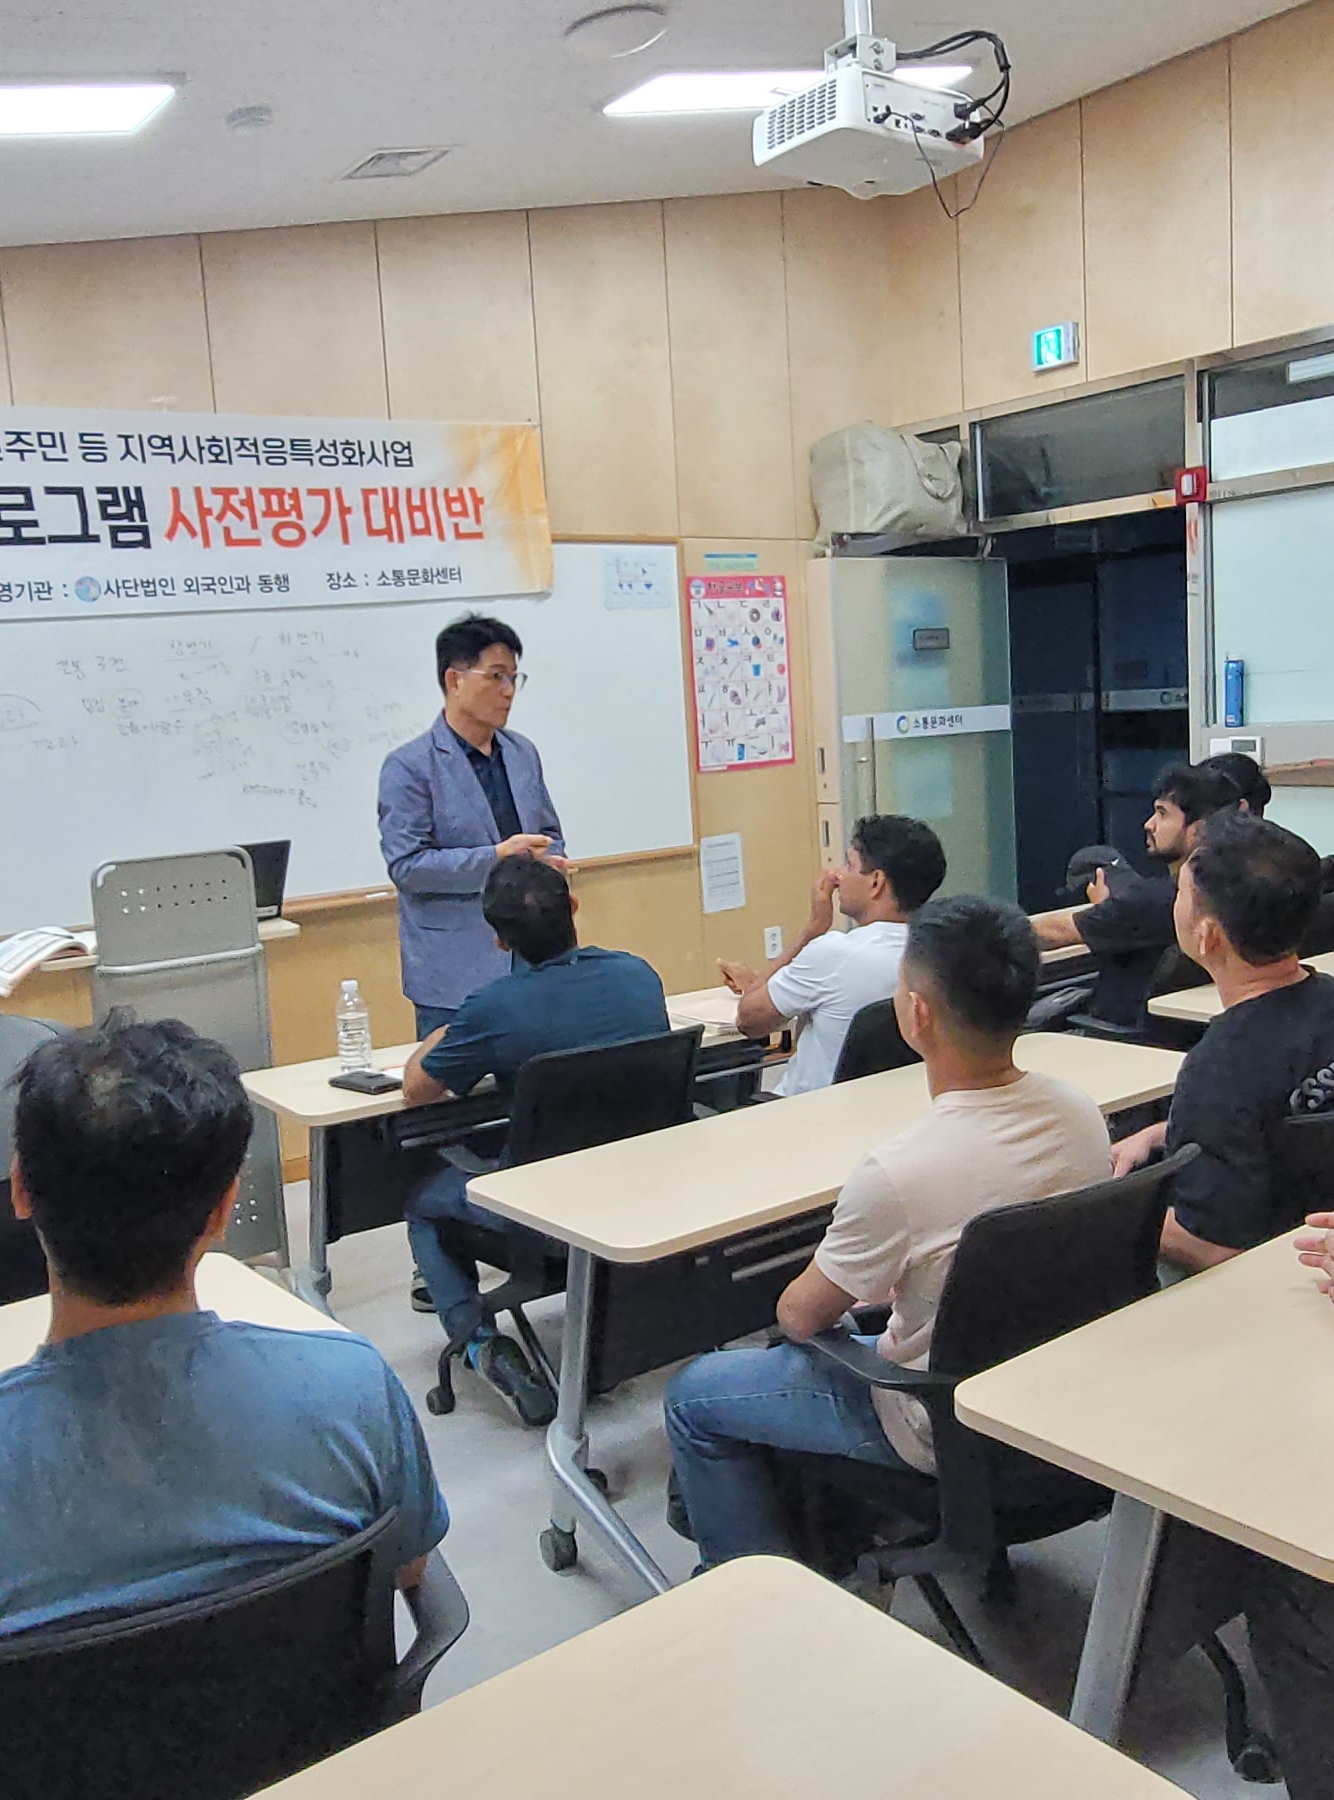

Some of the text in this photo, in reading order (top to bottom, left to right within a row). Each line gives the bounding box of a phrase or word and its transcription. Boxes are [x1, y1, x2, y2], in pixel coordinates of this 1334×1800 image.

[78, 432, 108, 463] 등
[116, 433, 414, 468] 지역사회적응특성화사업
[164, 486, 353, 549] 사전평가
[362, 486, 486, 544] 대비반
[103, 577, 176, 599] 사단법인
[183, 575, 251, 596] 외국인과
[257, 574, 291, 594] 동행
[326, 572, 358, 590] 장소
[377, 567, 462, 587] 소통문화센터
[717, 600, 725, 608] ㄴ
[739, 600, 747, 608] ㄷ
[695, 629, 702, 637] ㅁ
[742, 627, 750, 636] ㅅ
[764, 627, 771, 635] ㅇ
[913, 714, 963, 730] 소통문화센터
